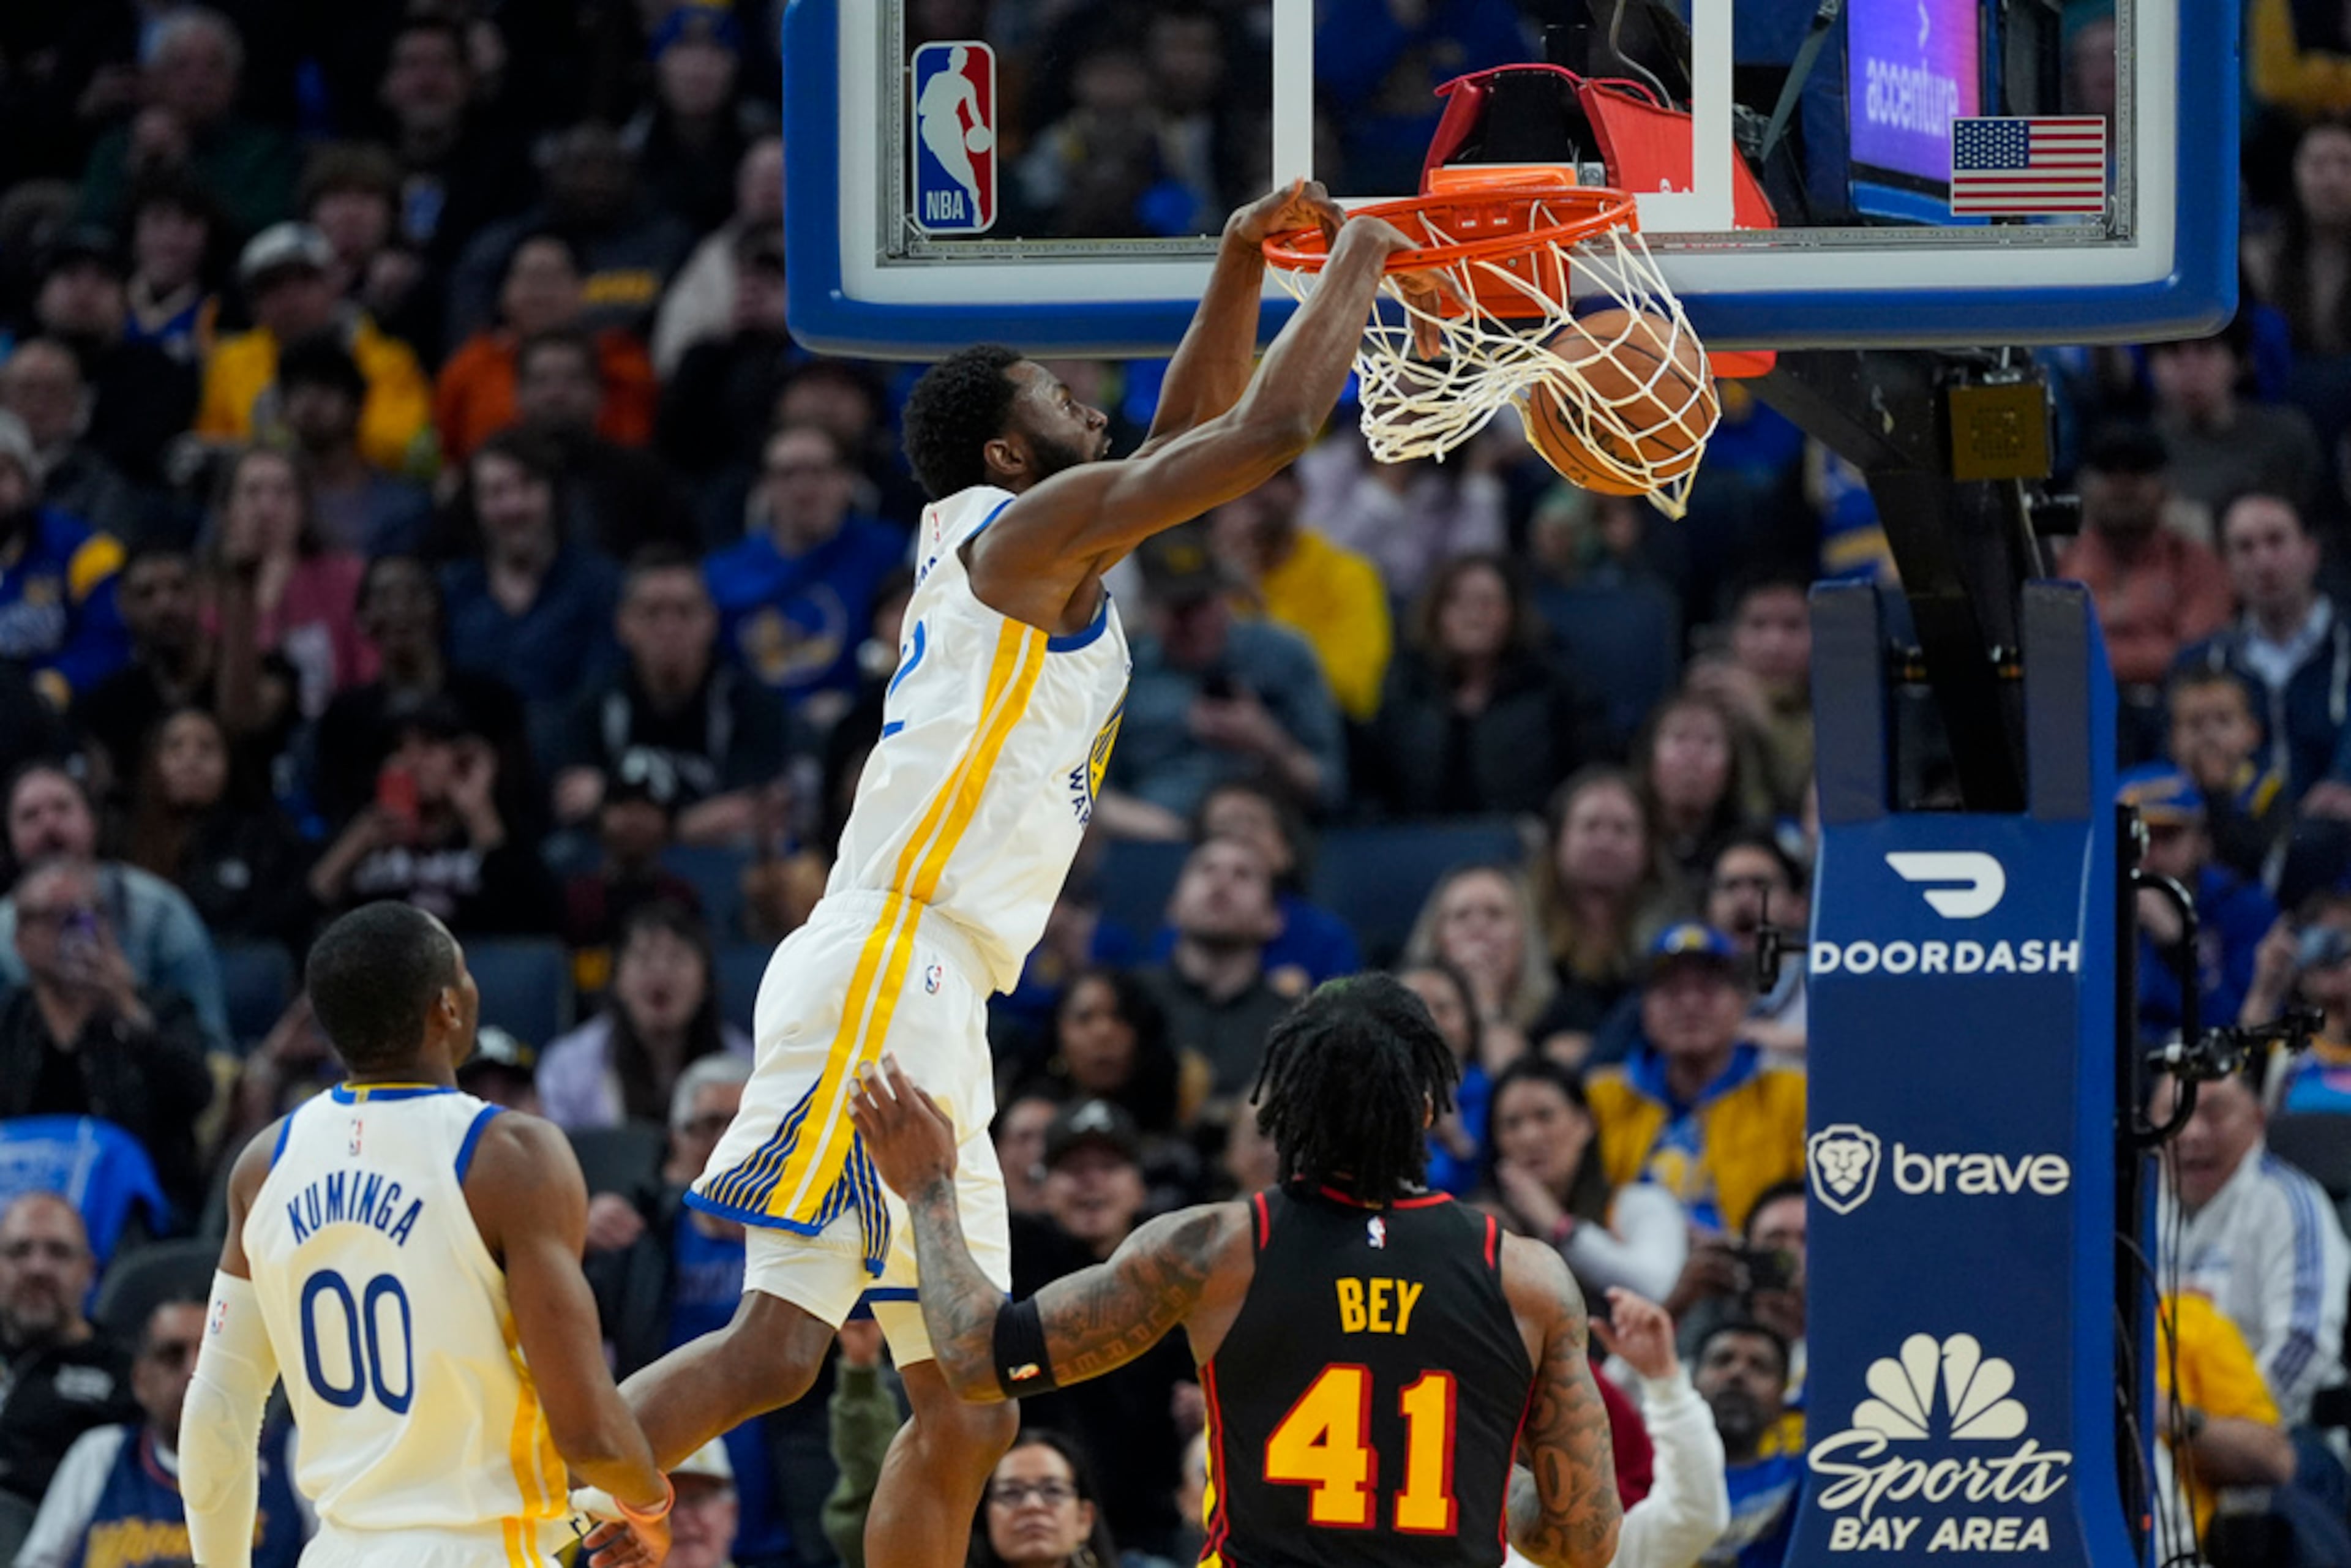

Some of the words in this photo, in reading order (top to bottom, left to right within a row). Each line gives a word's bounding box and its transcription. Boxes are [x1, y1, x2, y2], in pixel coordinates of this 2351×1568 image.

[1866, 56, 1959, 138] accenture
[926, 190, 966, 221] NBA
[1810, 940, 2079, 975] DOORDASH
[1892, 1142, 2071, 1196] brave
[287, 1170, 424, 1247] KUMINGA
[1335, 1277, 1424, 1335] BEY
[300, 1269, 414, 1415] 00
[1262, 1362, 1458, 1537] 41
[1807, 1425, 2073, 1526] Sports
[1828, 1517, 1922, 1551] BAY
[1926, 1517, 2050, 1553] AREA
